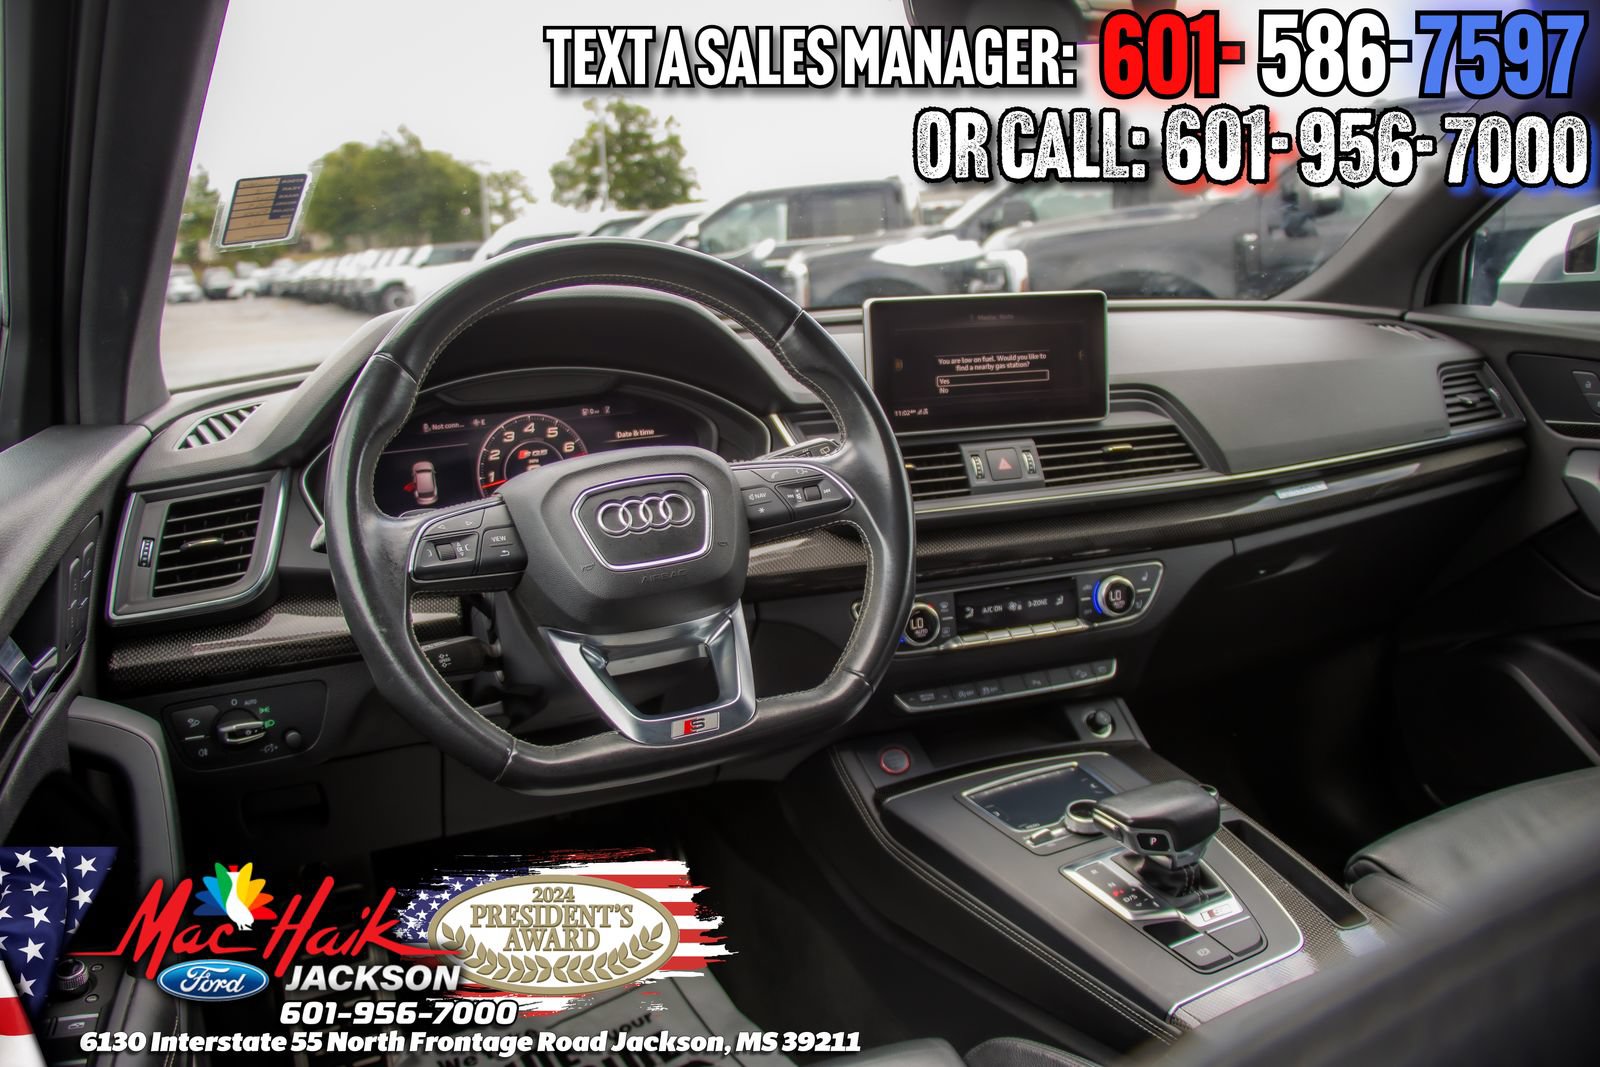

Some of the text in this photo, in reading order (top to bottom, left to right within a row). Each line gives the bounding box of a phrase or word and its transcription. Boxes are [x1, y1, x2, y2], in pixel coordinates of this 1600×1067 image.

[997, 354, 1016, 362] Would
[974, 363, 994, 372] nearby
[995, 363, 1006, 371] gas
[1007, 361, 1030, 369] station?
[432, 423, 444, 431] Not
[522, 422, 535, 433] 4
[546, 426, 559, 438] 5
[503, 431, 516, 443] 3
[616, 428, 655, 439] Date & time
[563, 441, 576, 453] 6
[489, 449, 501, 460] 2
[488, 471, 495, 482] 1
[490, 535, 507, 543] VIEW
[1109, 590, 1122, 602] LO
[982, 606, 993, 614] A/C
[911, 617, 924, 630] LO
[1150, 837, 1157, 846] P
